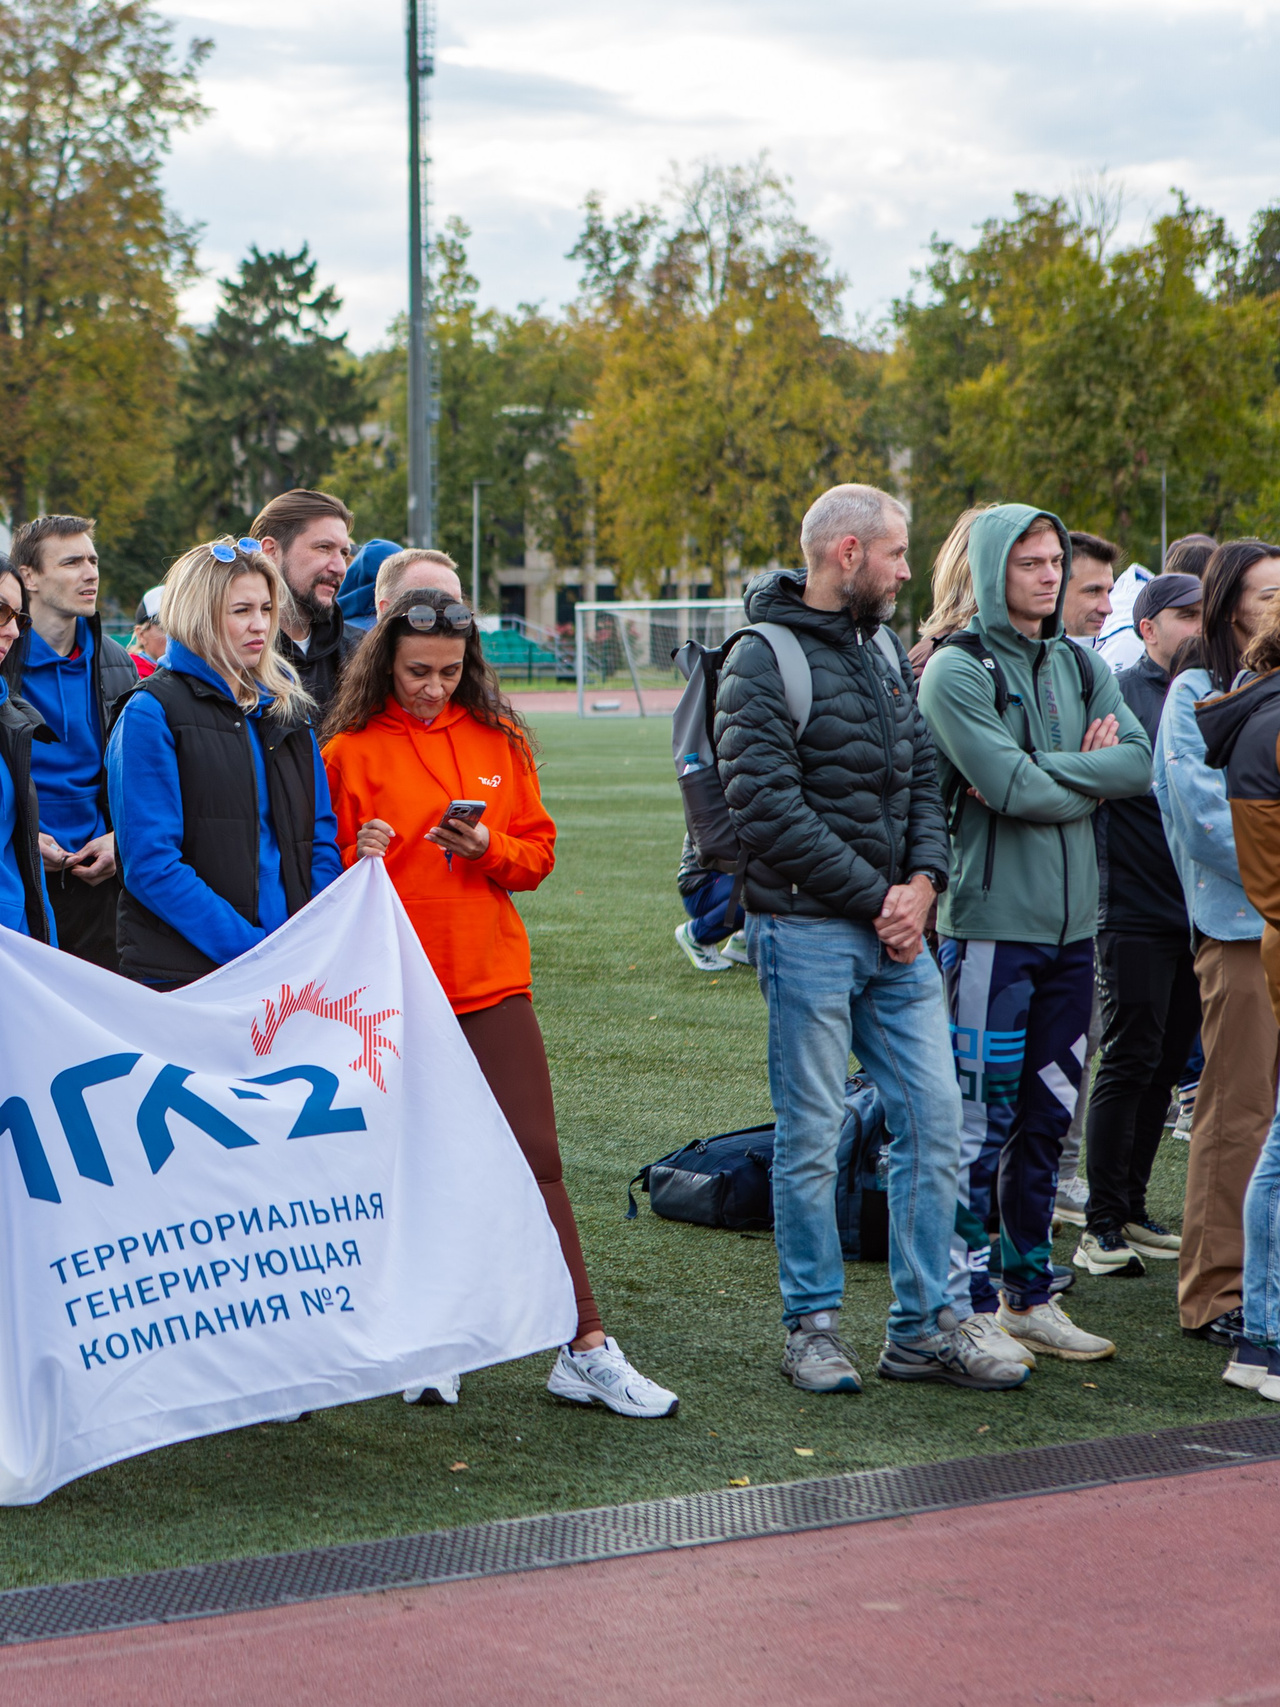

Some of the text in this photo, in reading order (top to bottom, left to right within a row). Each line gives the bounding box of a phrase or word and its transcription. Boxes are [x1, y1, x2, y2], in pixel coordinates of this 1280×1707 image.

[49, 1192, 385, 1286] ТЕРРИТОРИАЛЬНАЯ
[65, 1239, 362, 1328] ГЕНЕРИРУЮЩАЯ
[78, 1285, 355, 1371] КОМПАНИЯ №2
